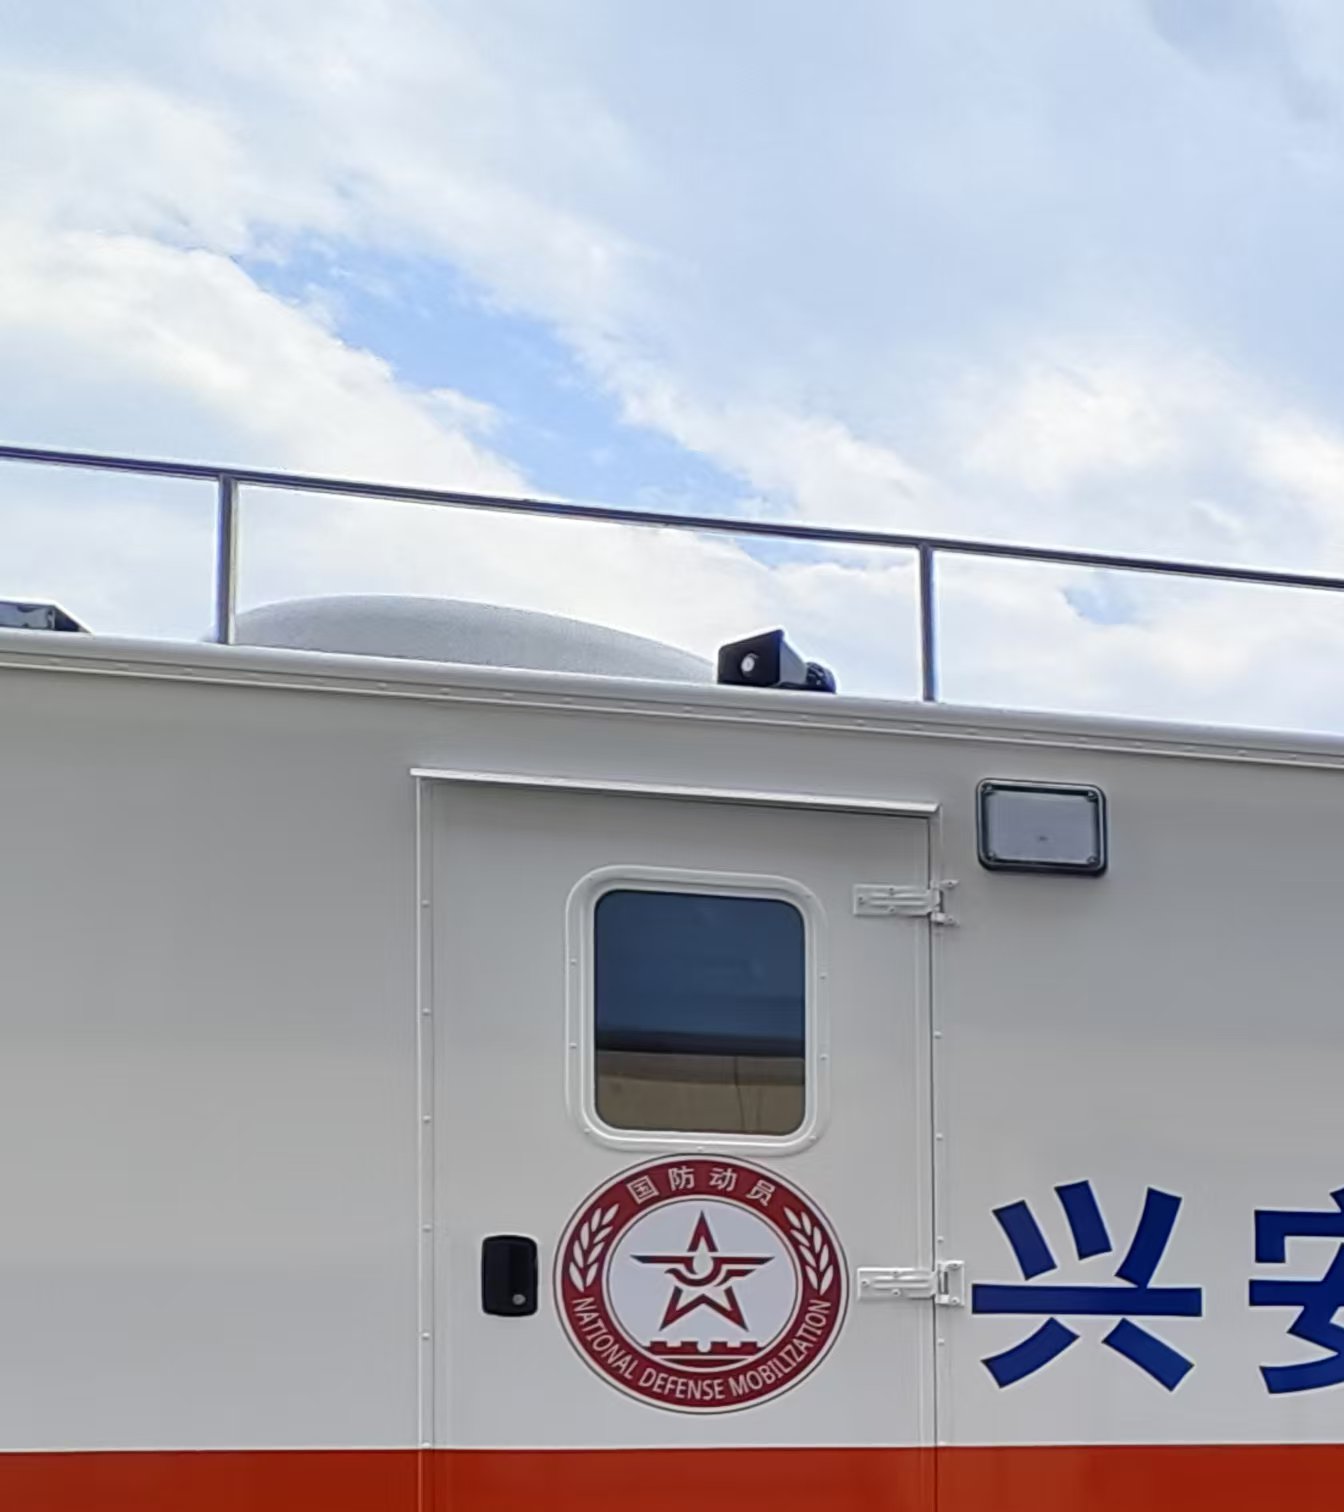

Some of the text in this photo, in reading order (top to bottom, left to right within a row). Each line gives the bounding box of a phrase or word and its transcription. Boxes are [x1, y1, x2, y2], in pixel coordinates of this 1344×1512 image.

[626, 1165, 778, 1208] 国防动员
[572, 1296, 832, 1401] NATIONAL DEFENSE MOBILIZATION
